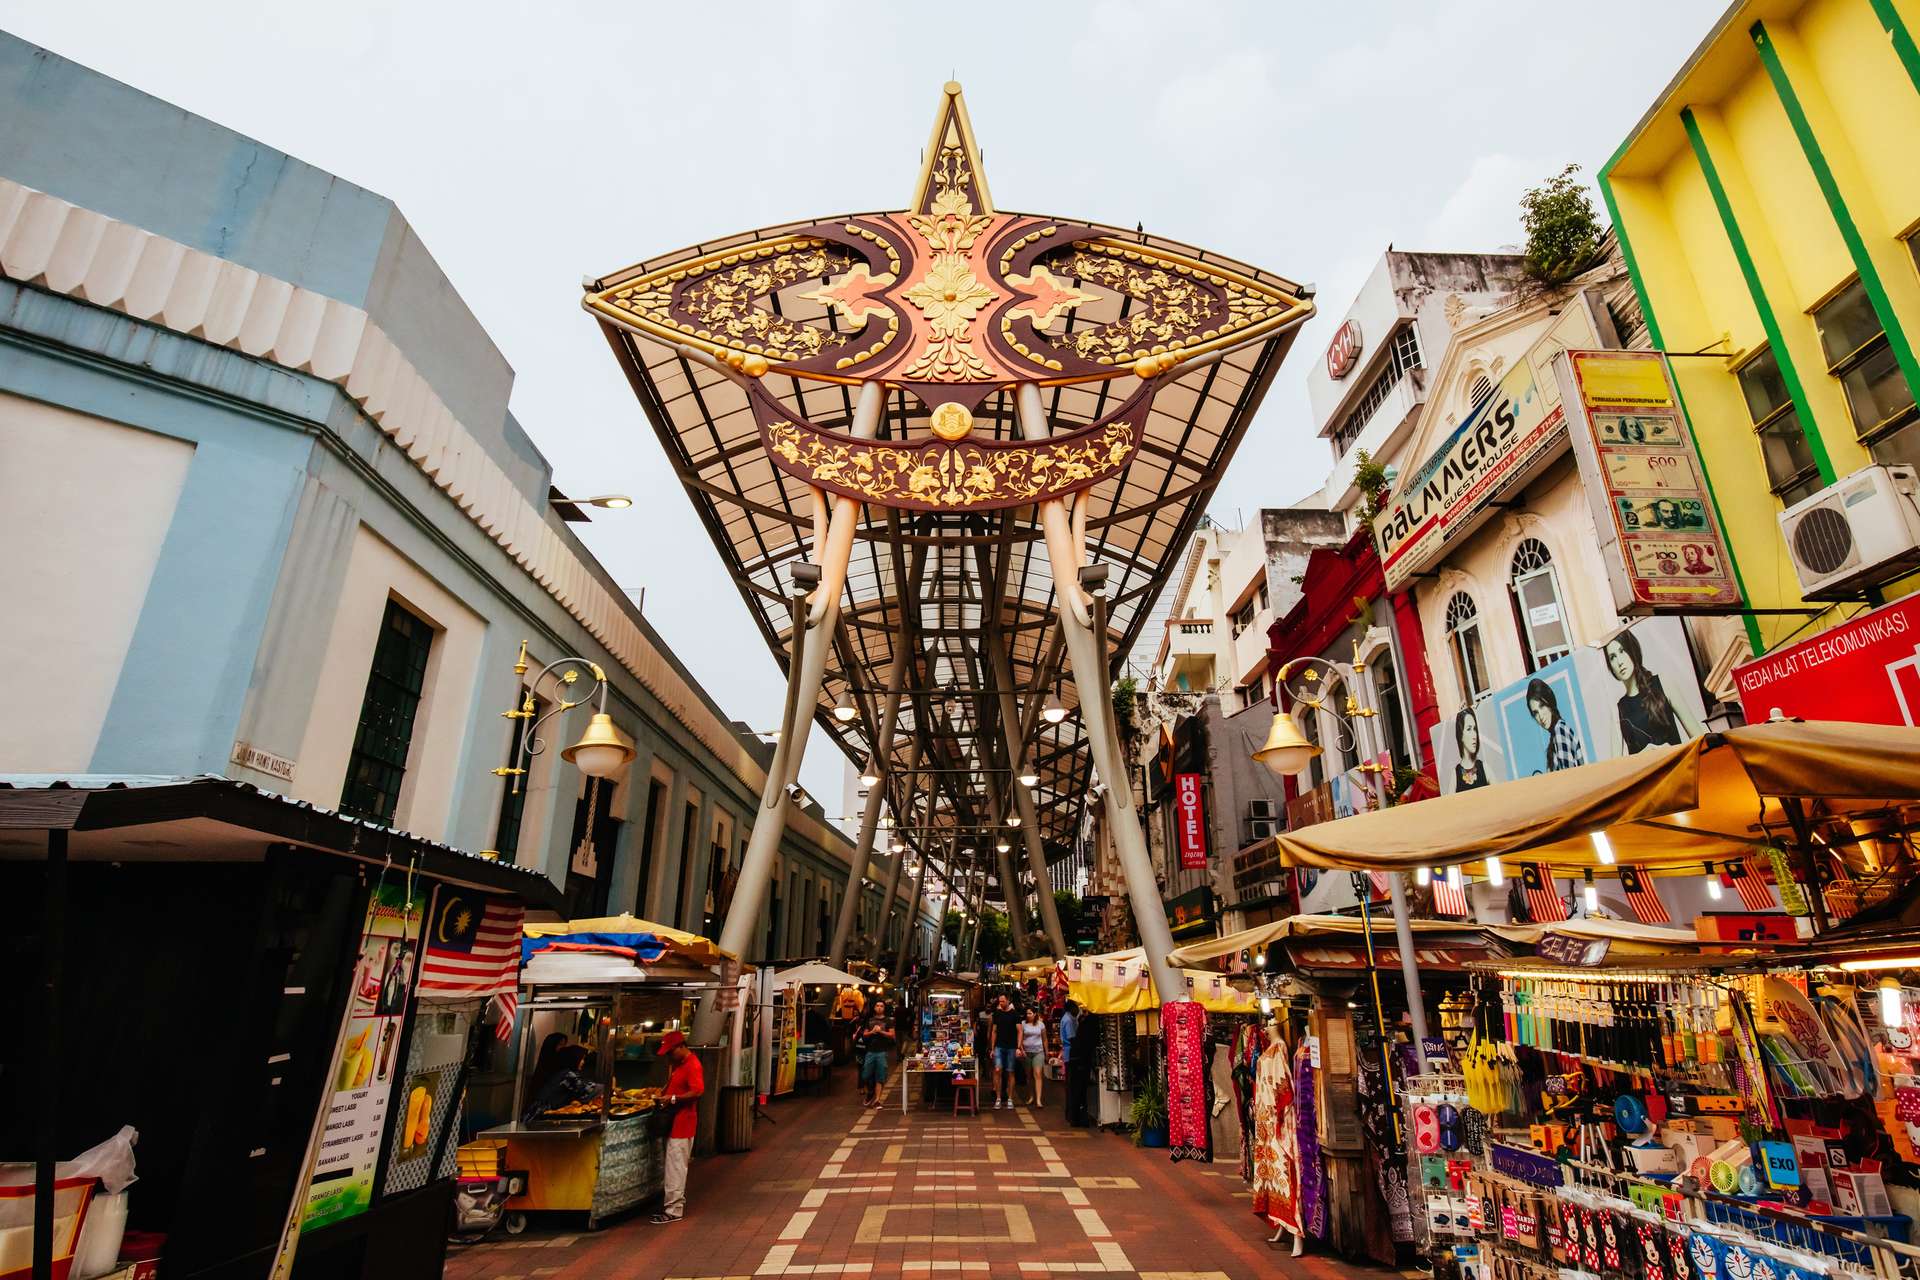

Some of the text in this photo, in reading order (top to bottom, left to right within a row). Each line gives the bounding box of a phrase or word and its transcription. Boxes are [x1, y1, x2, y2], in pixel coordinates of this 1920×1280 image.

[1443, 473, 1476, 509] GUEST
[1479, 433, 1519, 475] HOUSE
[1446, 498, 1469, 521] WHERE
[1469, 456, 1514, 500] HOSPITALITY
[1512, 430, 1541, 461] MEETS
[1540, 413, 1560, 433] THE
[1403, 474, 1423, 497] RUMAH
[1680, 500, 1701, 511] 100
[1655, 551, 1678, 560] 100
[1740, 610, 1910, 693] KEDAI ALAT TELEKOMUNIKASI
[1181, 777, 1199, 850] HOTEL
[352, 1091, 368, 1100] YOGURT
[321, 1137, 352, 1149] STRAWBERRY
[318, 1156, 337, 1167] BANANA
[1769, 1157, 1794, 1171] EXO
